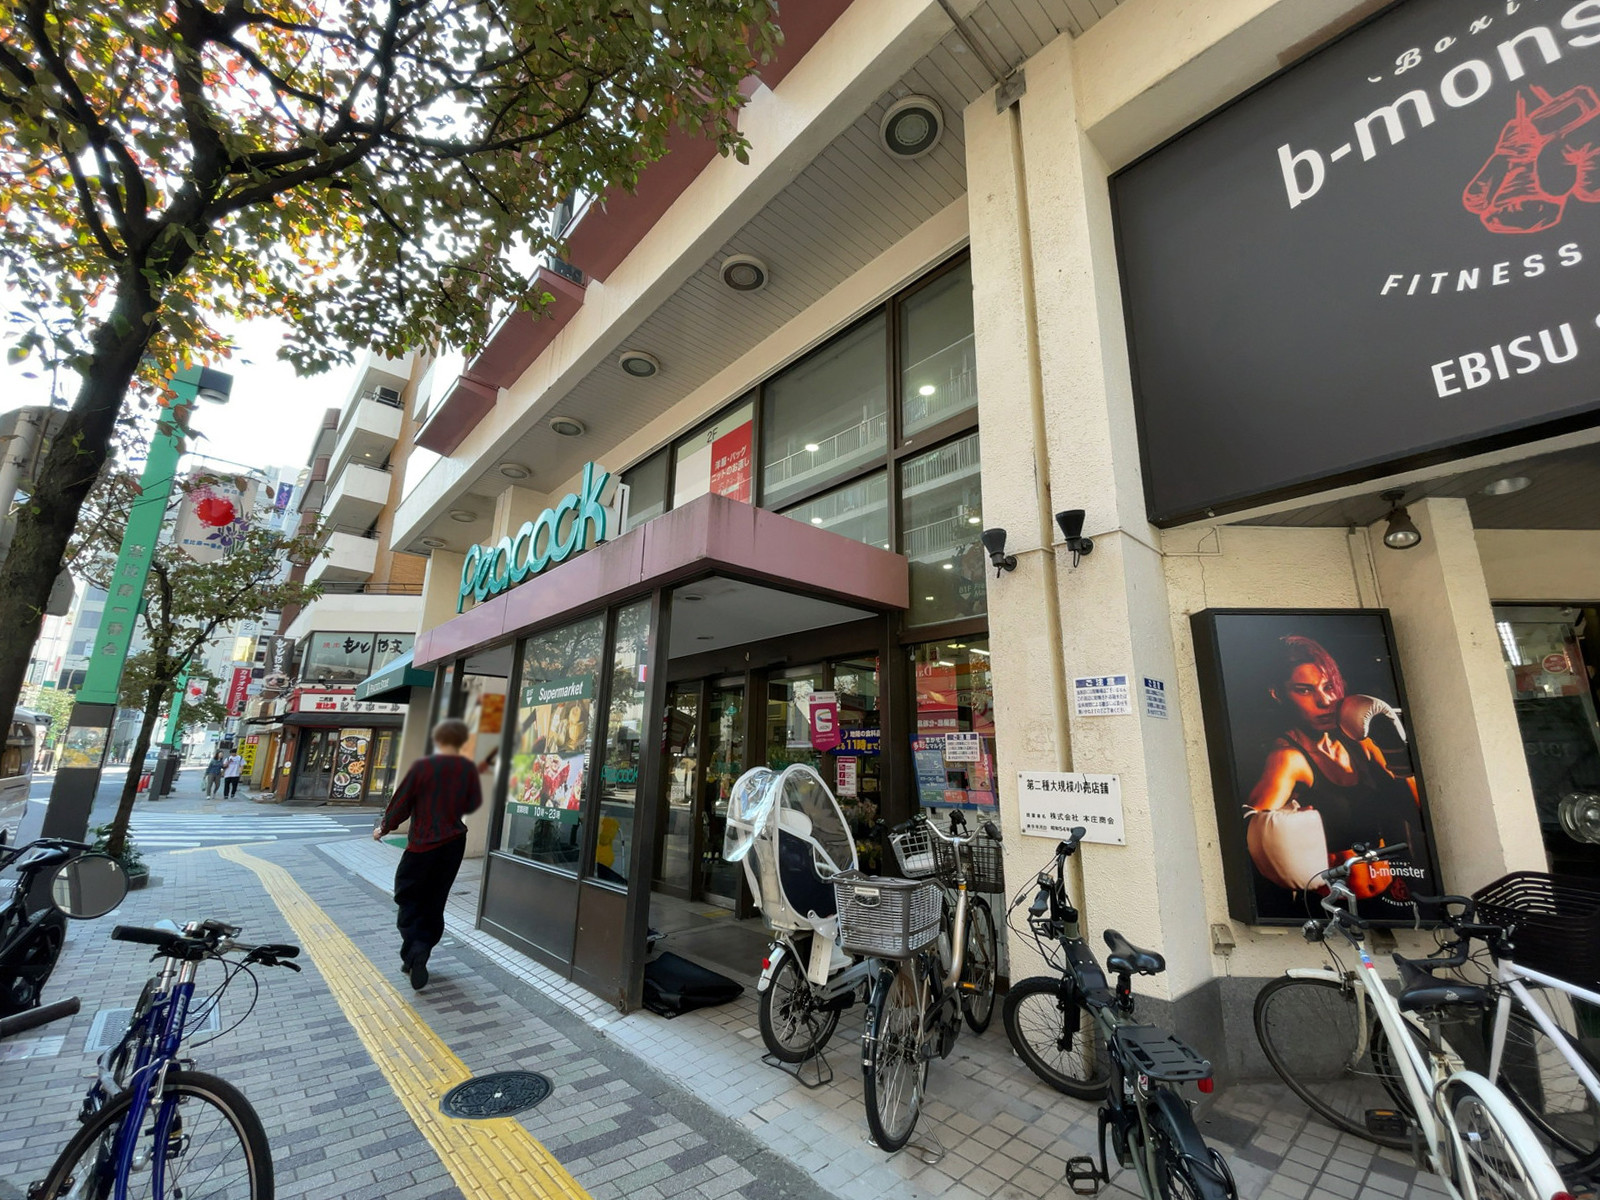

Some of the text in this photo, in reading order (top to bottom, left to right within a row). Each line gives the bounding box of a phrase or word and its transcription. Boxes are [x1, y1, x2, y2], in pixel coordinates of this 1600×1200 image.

[1394, 0, 1538, 76] Boxi
[1277, 0, 1600, 209] b-mons
[1380, 243, 1583, 296] FITNESS
[1431, 322, 1579, 398] EBISU
[707, 427, 718, 443] 2F
[538, 680, 585, 703] Supermarket
[1027, 779, 1109, 794] 第二種大規模小売店舗
[1050, 812, 1079, 822] 株式会社
[1369, 864, 1425, 879] b-monster
